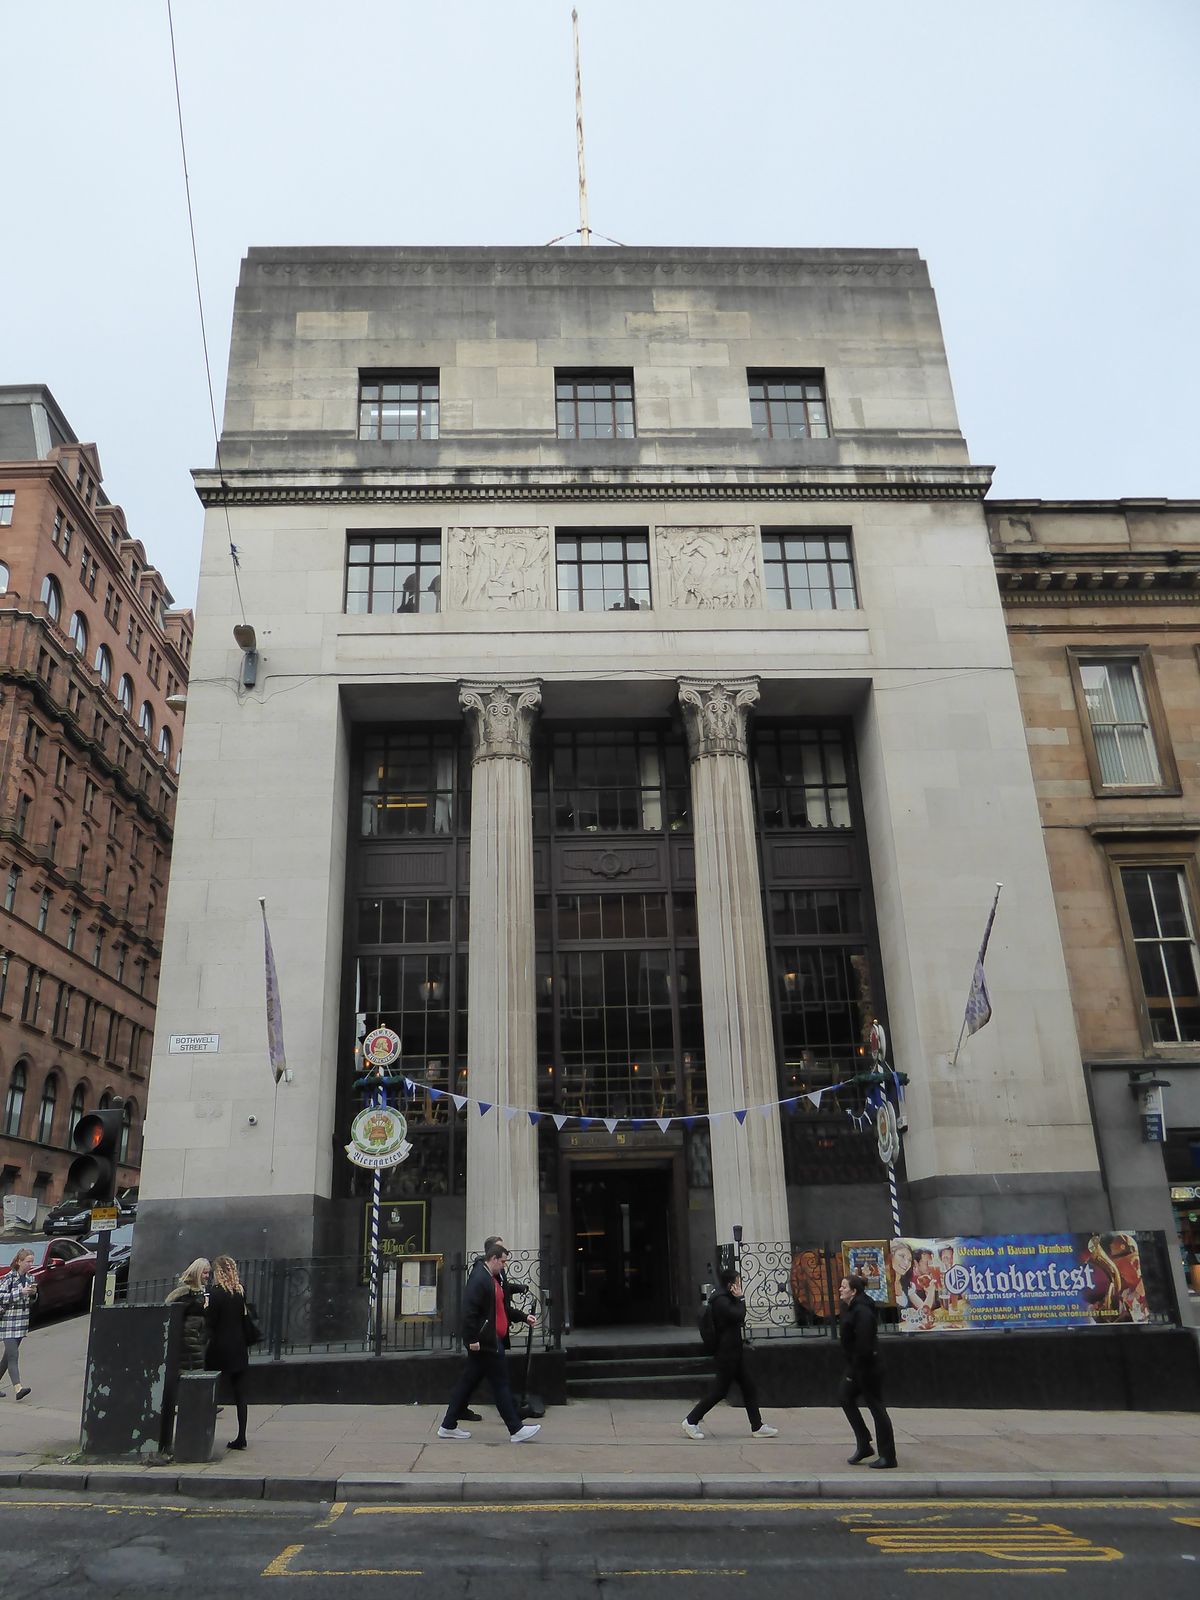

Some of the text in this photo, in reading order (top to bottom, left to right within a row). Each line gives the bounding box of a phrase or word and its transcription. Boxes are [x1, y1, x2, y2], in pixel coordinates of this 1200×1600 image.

[175, 1036, 215, 1044] BOTHWELL
[352, 1150, 404, 1167] Biergarten
[958, 1244, 1073, 1256] Weekends at Bavaria Brauhaus
[944, 1263, 1096, 1295] Oktoberfest
